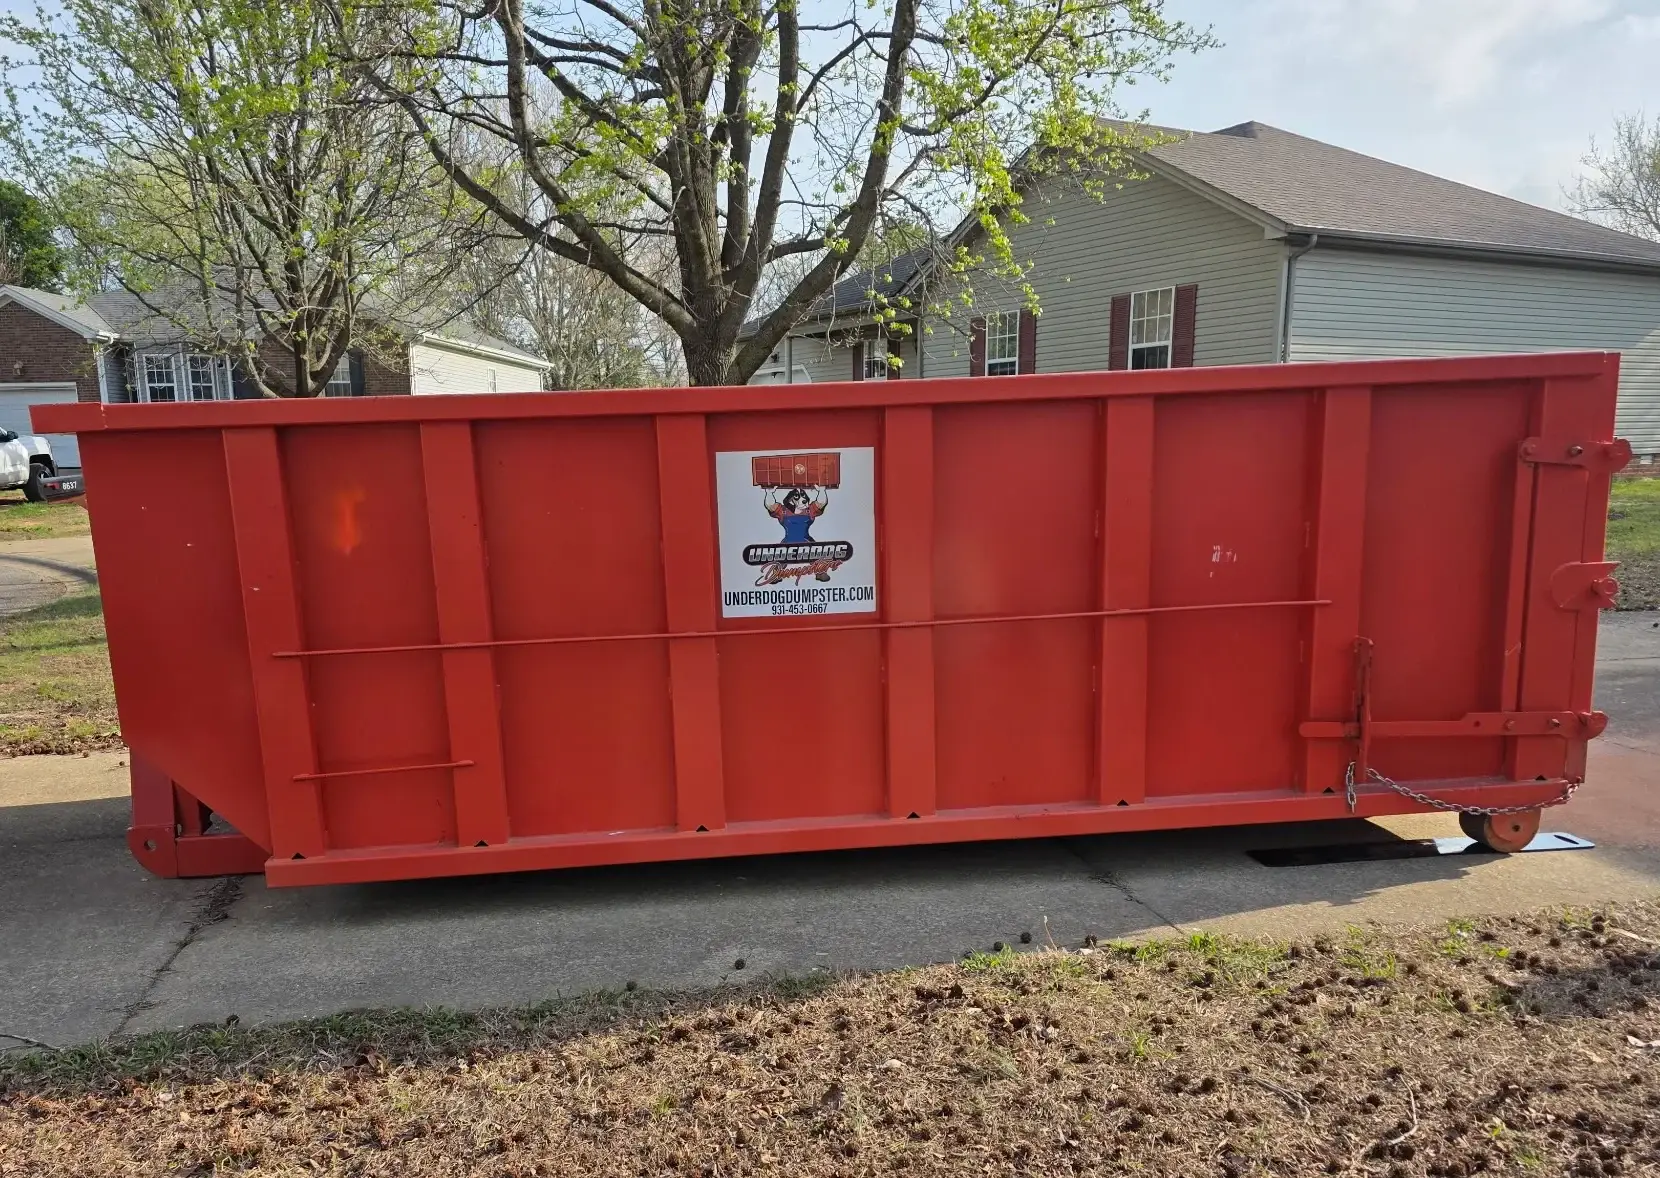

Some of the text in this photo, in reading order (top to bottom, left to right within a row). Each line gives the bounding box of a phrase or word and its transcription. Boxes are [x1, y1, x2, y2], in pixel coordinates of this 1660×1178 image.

[748, 544, 848, 562] UNDERDOG
[724, 586, 874, 606] UNDERDOGDUMPSTER.COM
[771, 603, 828, 616] 931-453-0667
